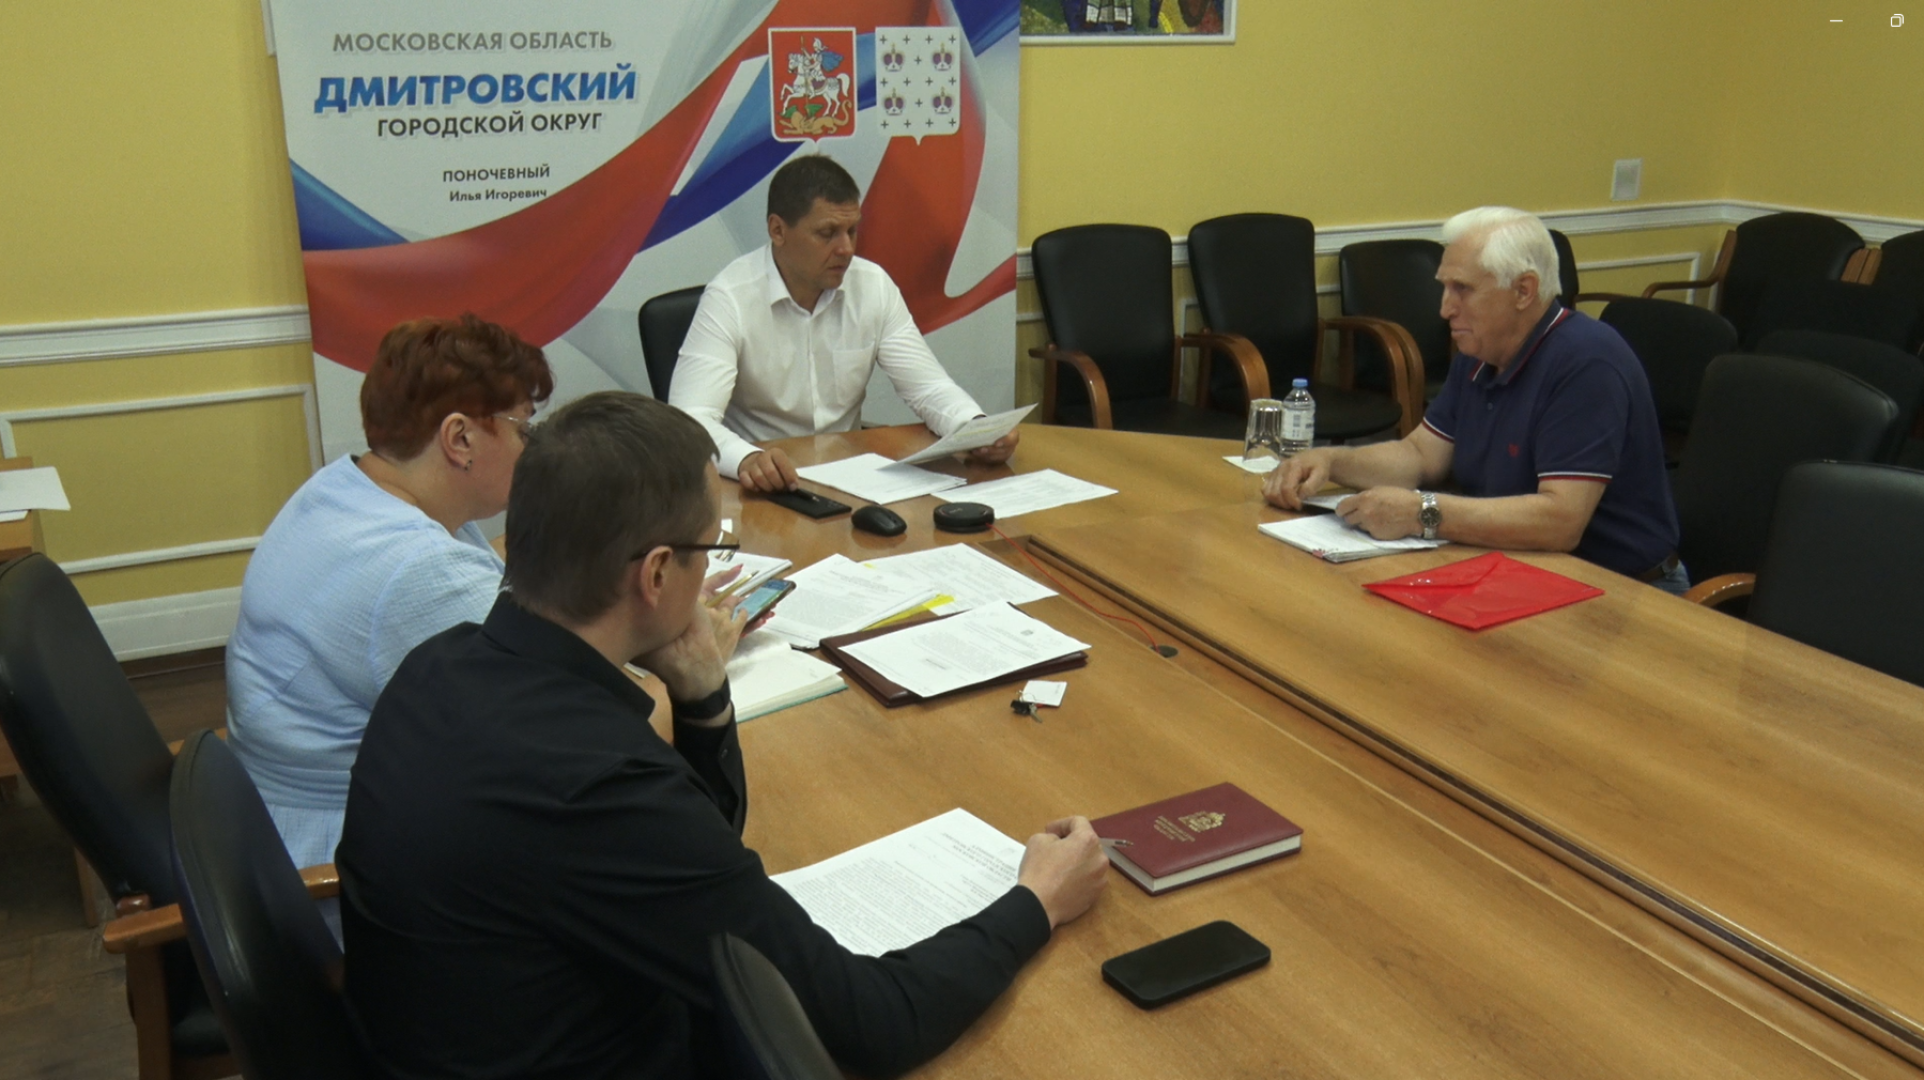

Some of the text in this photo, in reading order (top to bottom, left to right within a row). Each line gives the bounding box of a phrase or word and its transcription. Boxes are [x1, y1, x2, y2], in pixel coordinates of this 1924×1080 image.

[333, 31, 613, 52] МОСКОВСКАЯ ОБЛАСТЬ
[313, 63, 637, 113] ДМИТРОВСКИЙ
[377, 111, 603, 138] ГОРОДСКОЙ ОКРУГ
[443, 164, 550, 182] ПОНОЧЕВНЫЙ
[449, 188, 548, 202] Илья Игоревич
